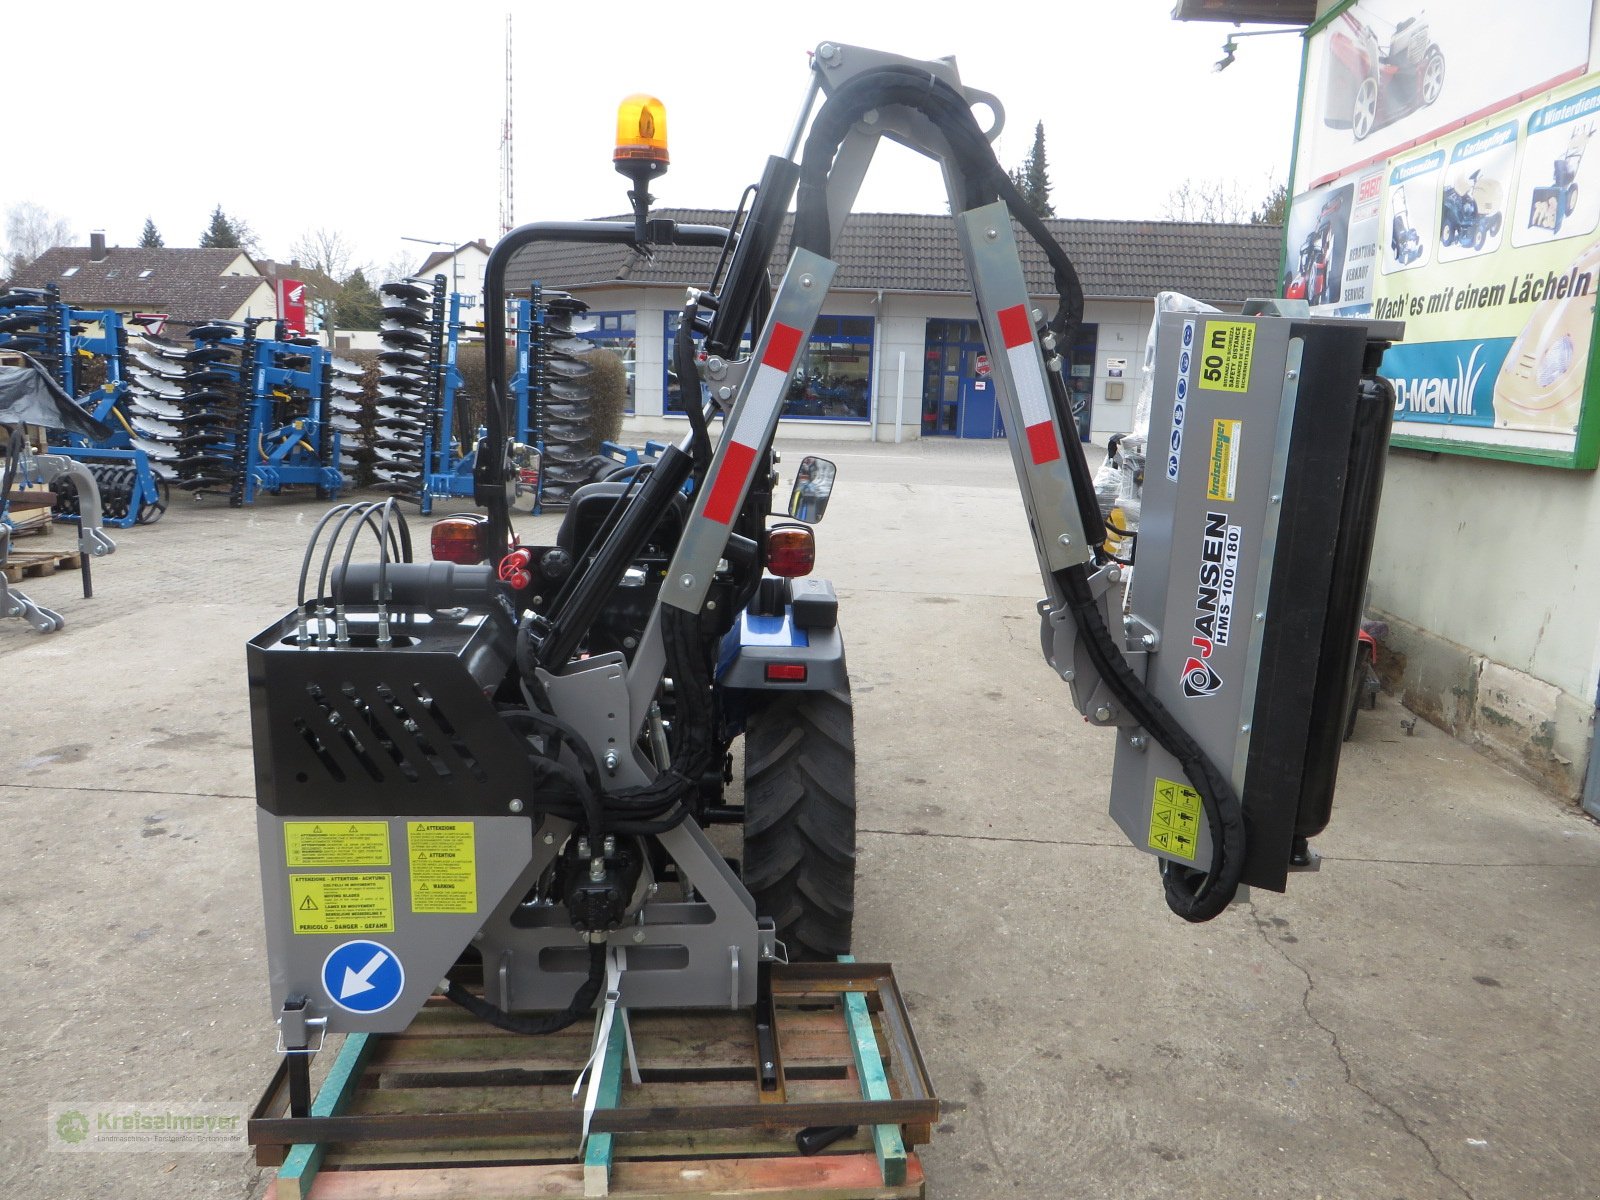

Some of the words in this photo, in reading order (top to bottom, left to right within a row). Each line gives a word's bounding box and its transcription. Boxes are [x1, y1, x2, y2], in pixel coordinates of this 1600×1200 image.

[1349, 243, 1376, 262] BERATUNG
[1345, 265, 1369, 282] VERKAUF
[1344, 286, 1365, 302] SERVICE
[1409, 299, 1423, 316] es
[1426, 293, 1452, 315] mit
[1452, 284, 1506, 311] einem
[1508, 267, 1592, 306] Lächeln
[1211, 330, 1227, 349] m
[1232, 326, 1241, 359] DISTANCE
[1203, 355, 1224, 382] 50
[1192, 512, 1228, 658] JANSEN
